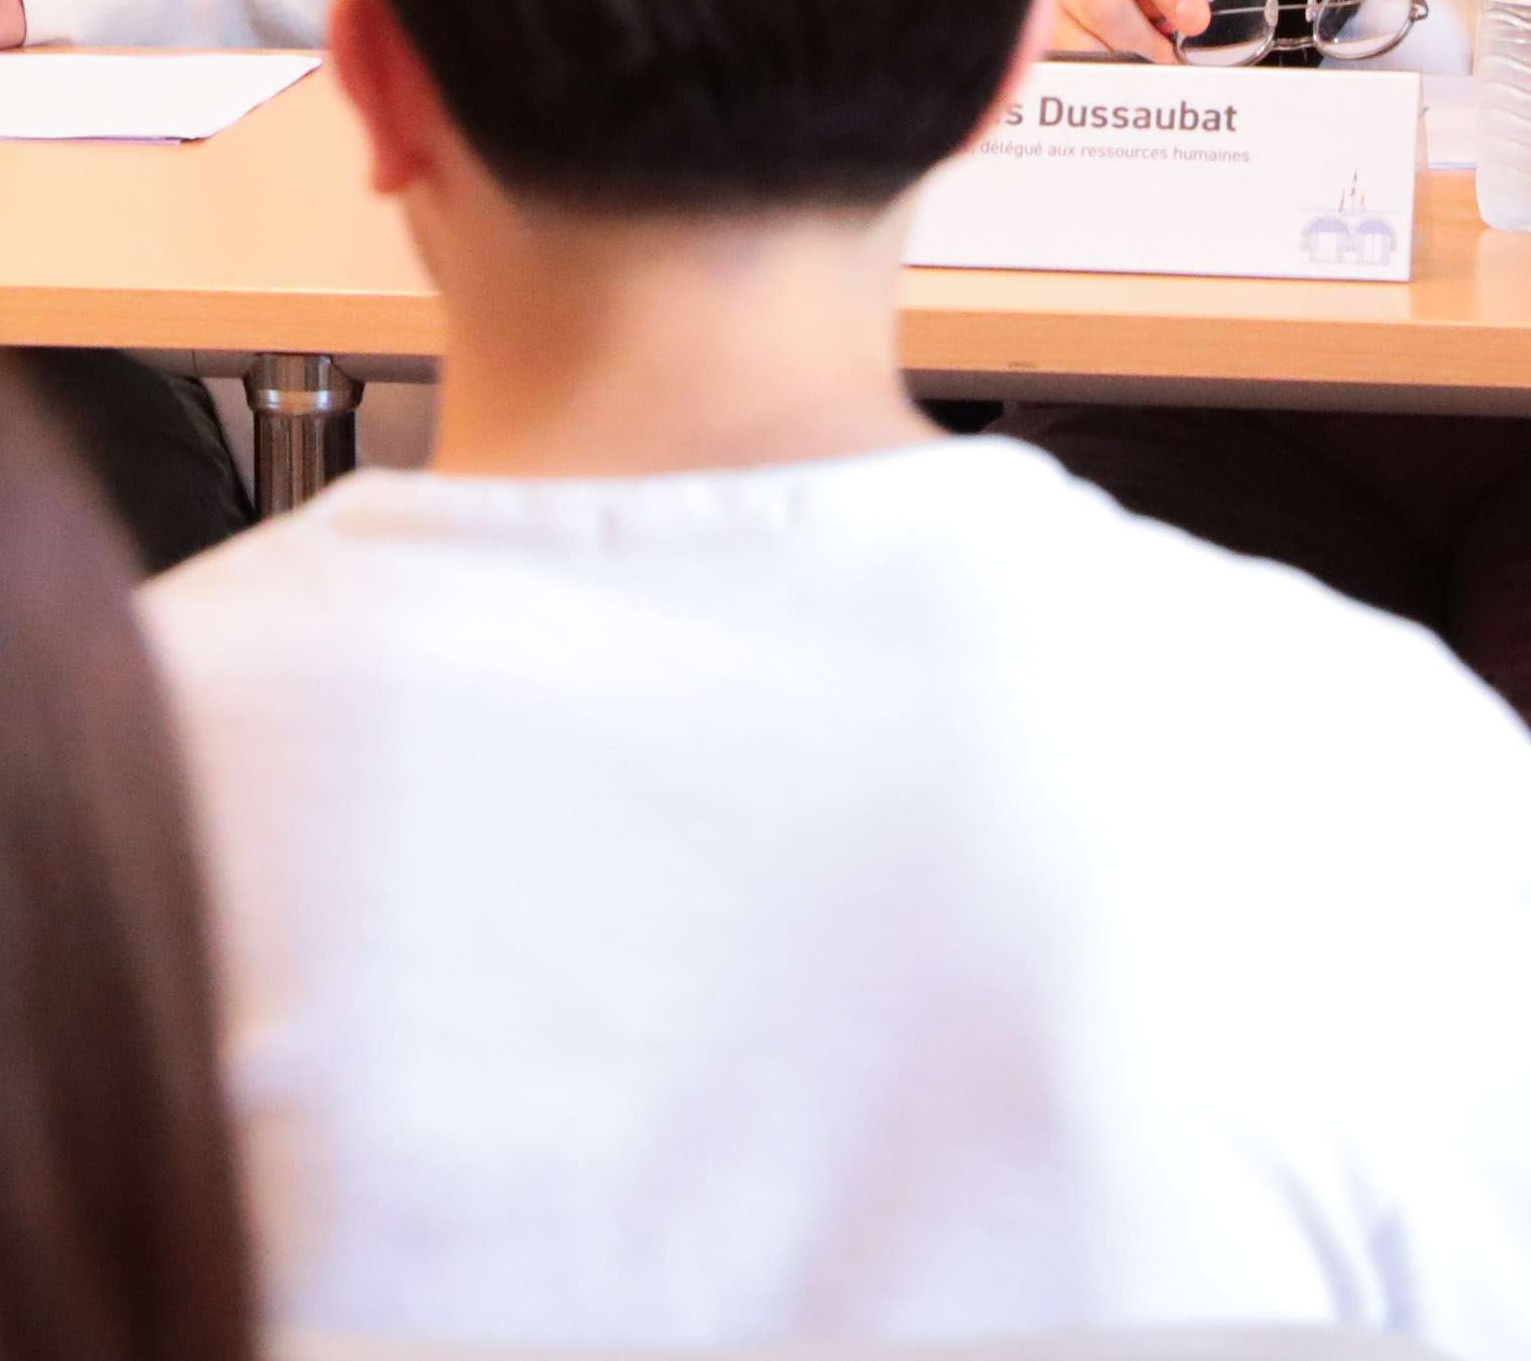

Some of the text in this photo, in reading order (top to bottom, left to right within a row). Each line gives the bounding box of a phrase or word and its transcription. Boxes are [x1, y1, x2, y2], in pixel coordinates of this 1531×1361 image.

[1039, 96, 1238, 133] Dussaubat
[980, 141, 1042, 159] délégué
[1048, 145, 1076, 158] aux
[1080, 146, 1168, 160] ressources
[1173, 147, 1250, 163] humaines
